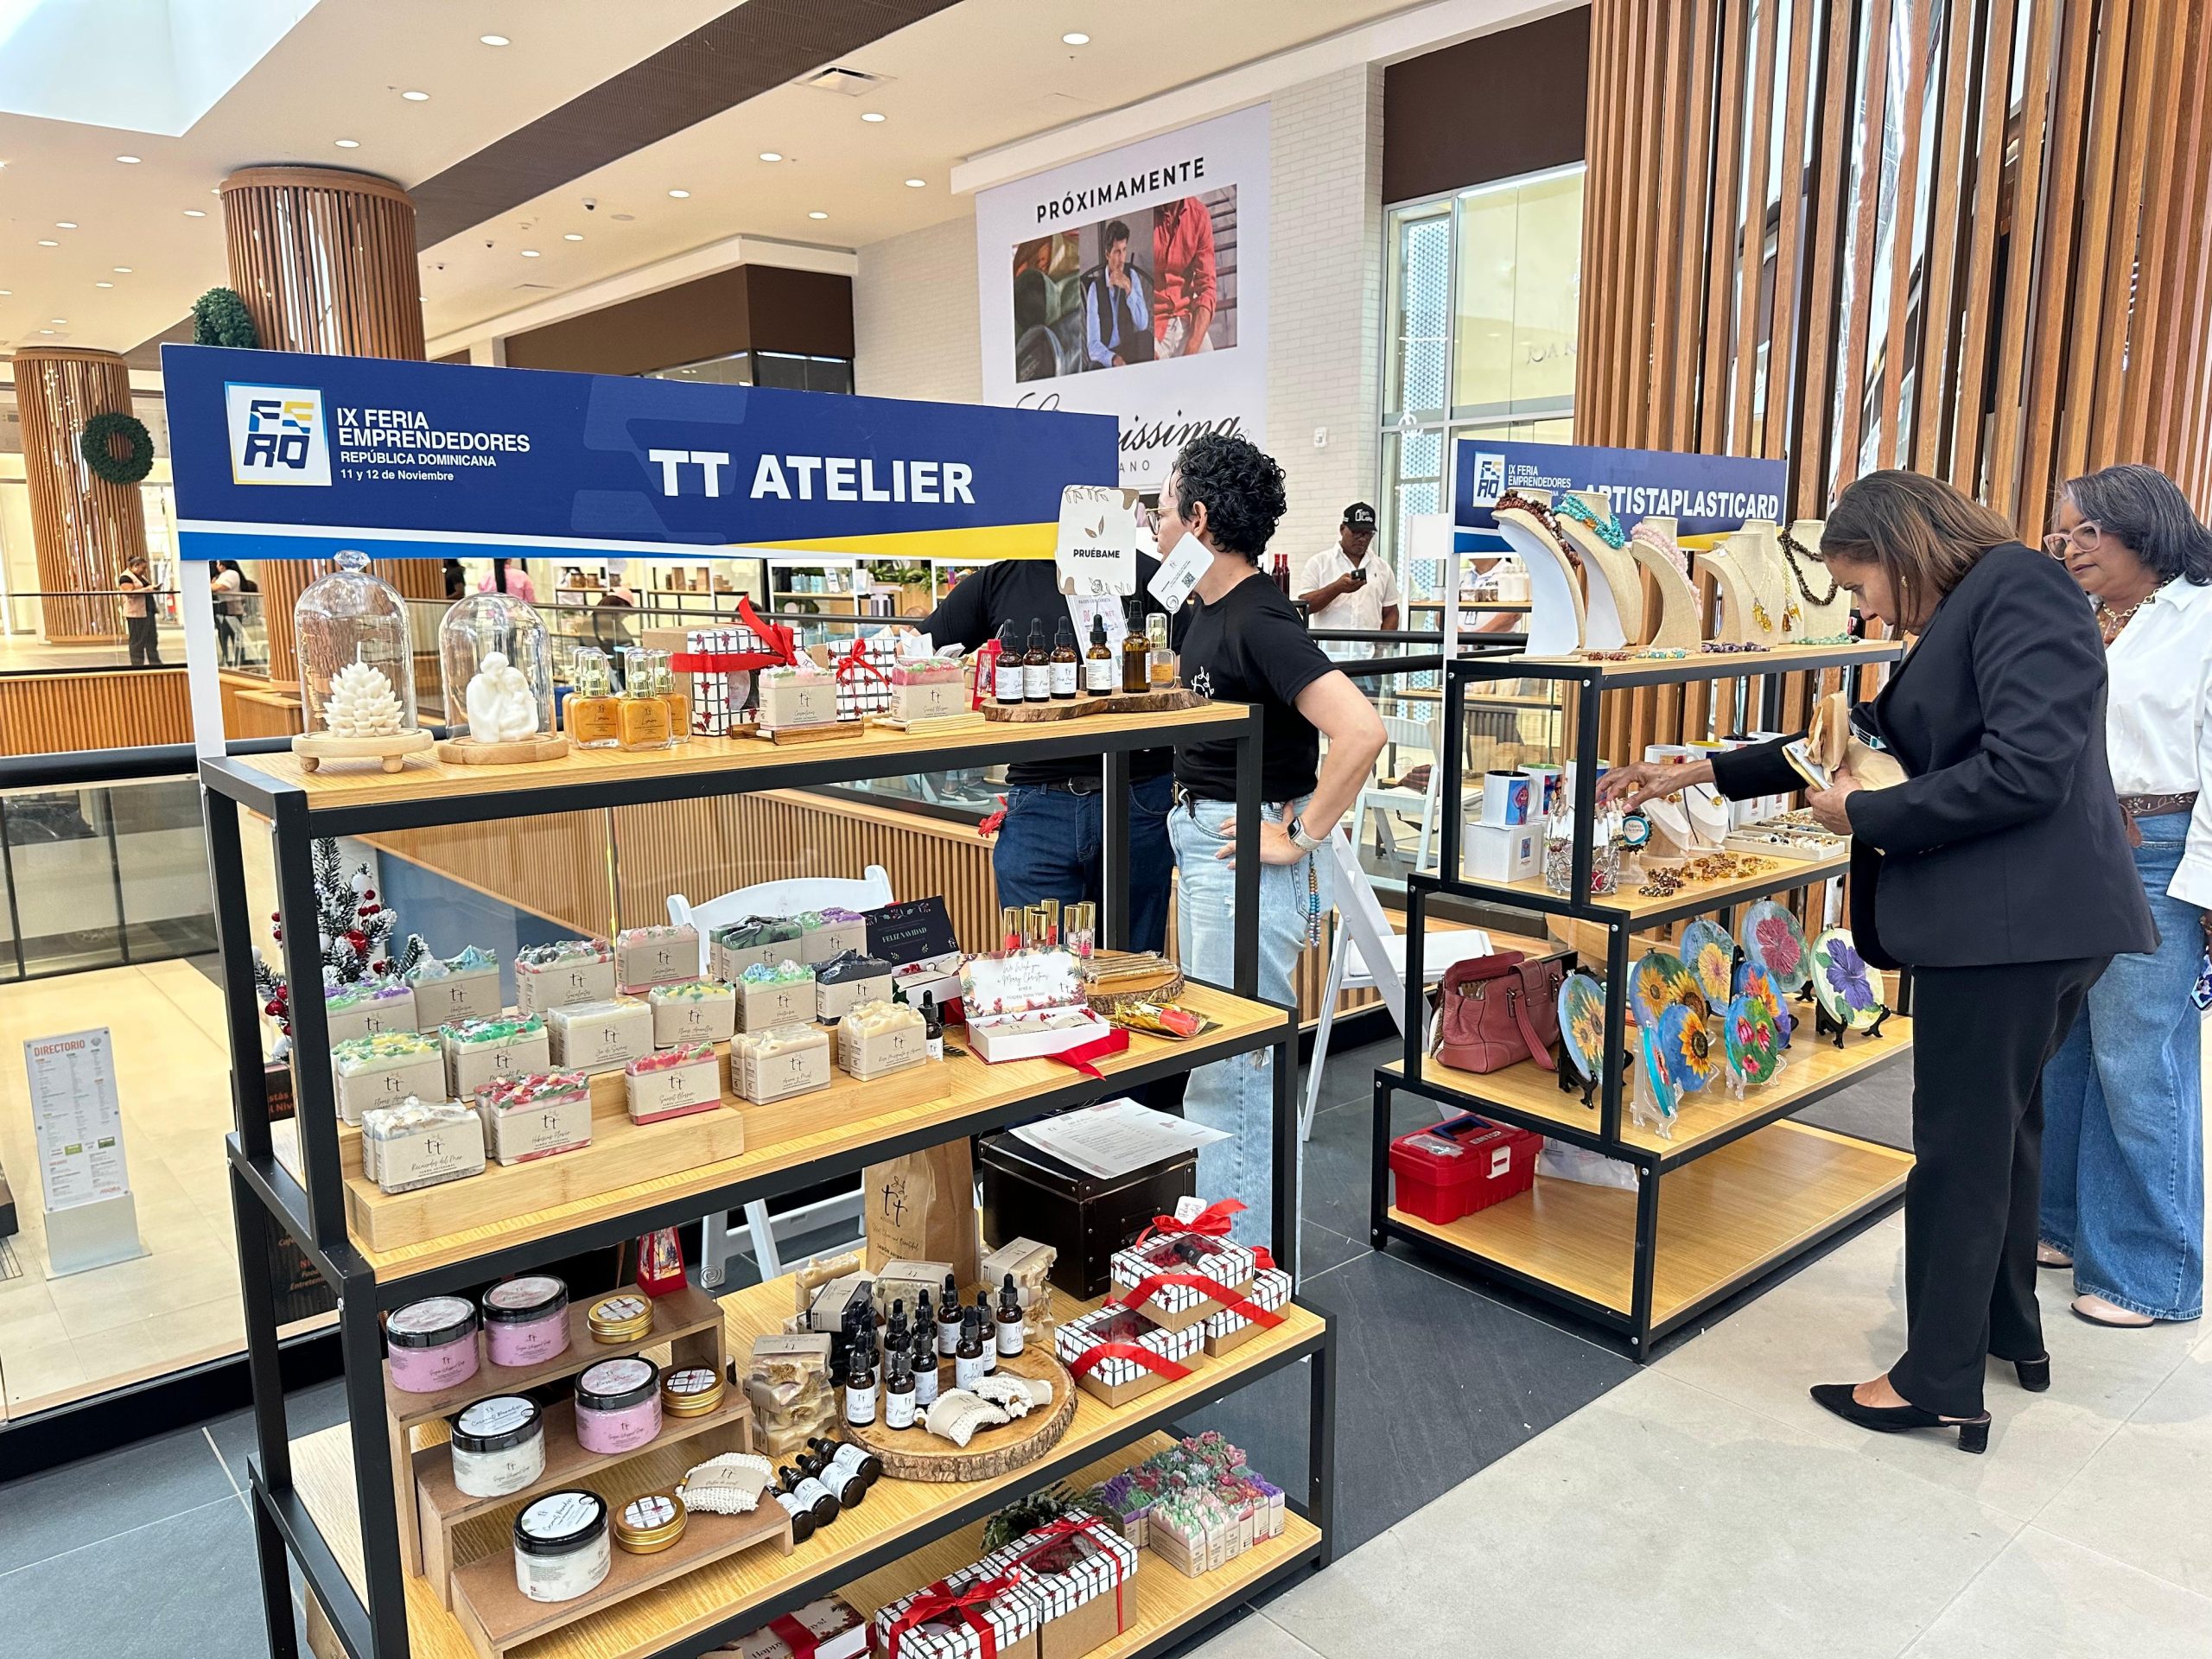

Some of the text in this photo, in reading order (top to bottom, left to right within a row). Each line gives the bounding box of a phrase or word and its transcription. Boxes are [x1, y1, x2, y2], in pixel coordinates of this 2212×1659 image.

[1037, 156, 1205, 223] PRÓXIMAMENTE
[337, 407, 429, 429] IX FERIA
[339, 428, 531, 453] EMPRENDEDORES
[340, 449, 497, 467] REPÚBLICA DOMINICANA
[340, 469, 454, 480] 11 y 12 de Noviembre
[649, 448, 976, 504] TT ATELIER
[1508, 464, 1539, 476] IX FERIA
[1508, 477, 1572, 489] EMPRENDEDORES
[1586, 484, 1779, 520] RTISTAPLASTICARD
[1073, 547, 1121, 558] PRUÉBAME
[881, 926, 927, 943] FELIZ NAVIDAD
[34, 1039, 86, 1058] DIRECTORIO
[752, 1641, 783, 1659] Happy
